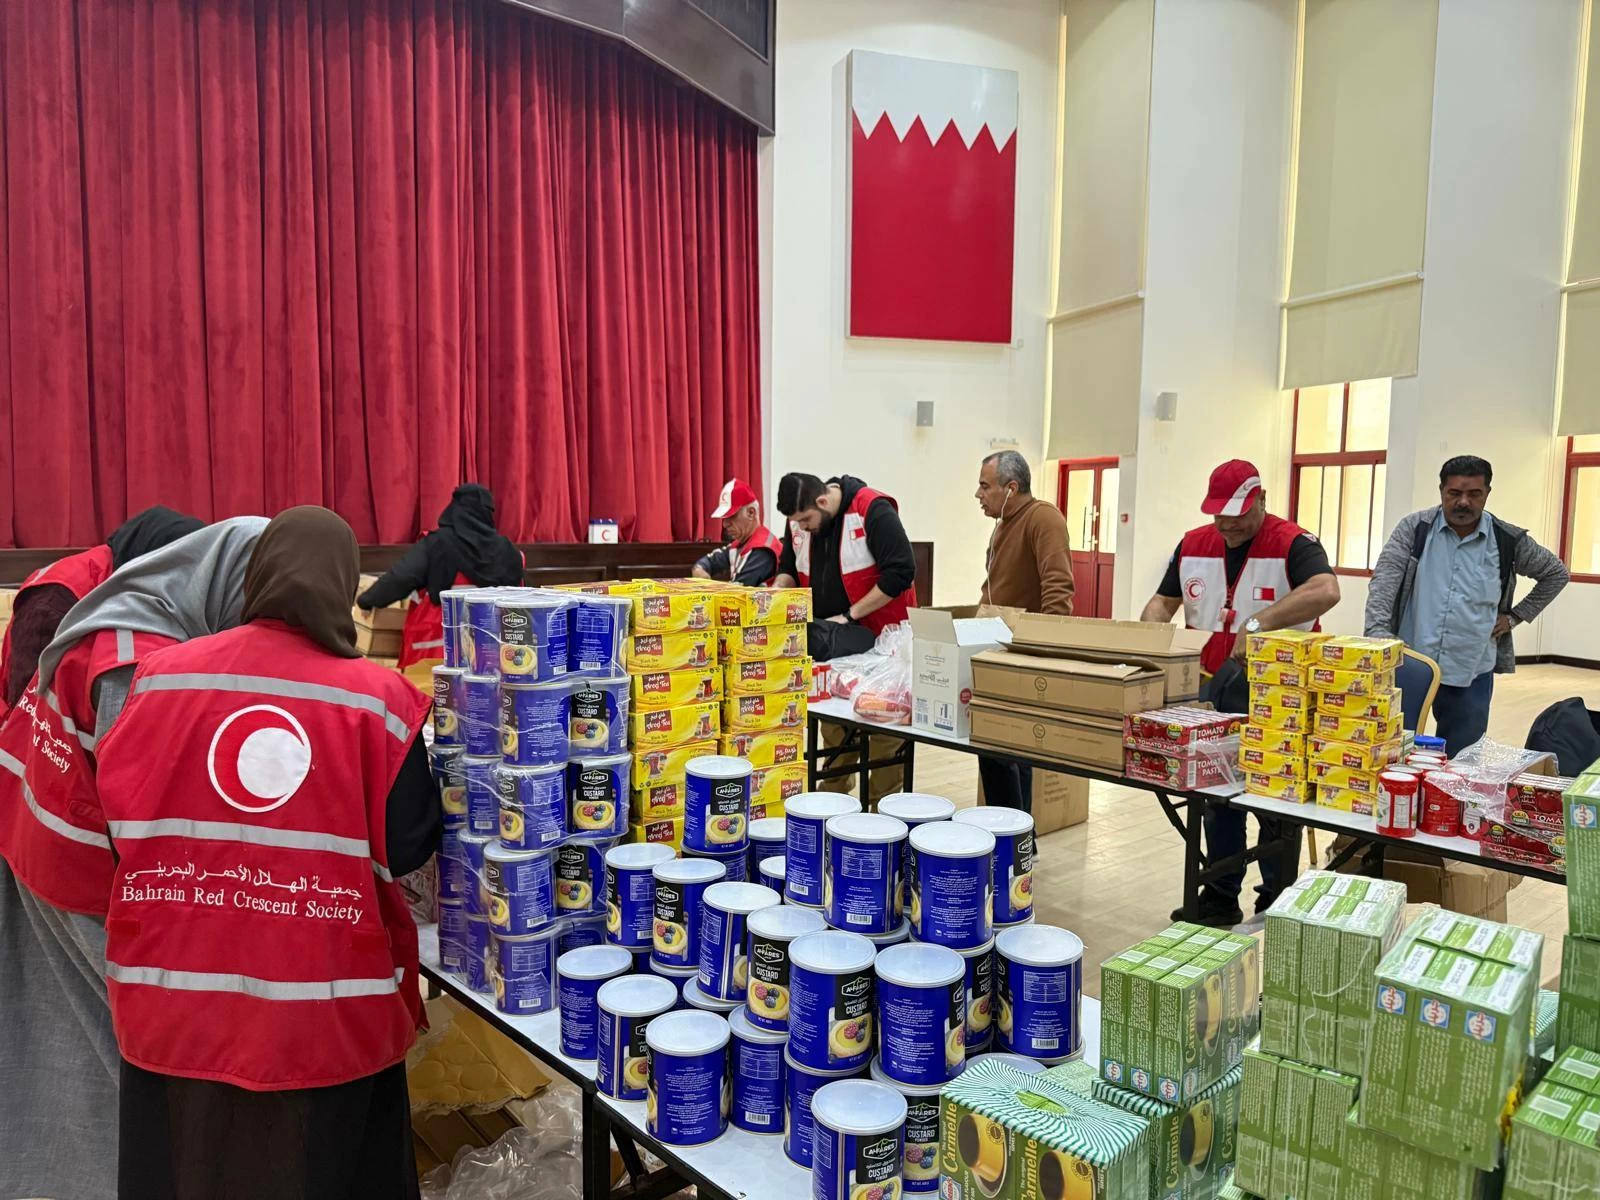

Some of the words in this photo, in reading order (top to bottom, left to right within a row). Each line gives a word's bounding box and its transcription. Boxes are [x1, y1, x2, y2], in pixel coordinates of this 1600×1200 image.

[1197, 726, 1224, 737] TOMATO
[1138, 739, 1161, 748] TOMATO
[41, 740, 71, 774] Society
[583, 789, 604, 797] CUSTARD
[1534, 814, 1563, 824] TOMA
[253, 868, 307, 893] الهلال
[121, 884, 186, 902] Bahrain
[194, 887, 224, 906] Red
[233, 890, 298, 915] Crescent
[305, 900, 363, 925] Society
[657, 908, 675, 917] CUSTARD
[756, 969, 779, 979] CUSTARD
[845, 1001, 867, 1014] CUSTARD
[907, 1129, 935, 1138] CUSTARD
[943, 1103, 958, 1173] Carmelle
[1166, 1115, 1179, 1188] Carmelle
[868, 1164, 894, 1178] CUSTARD
